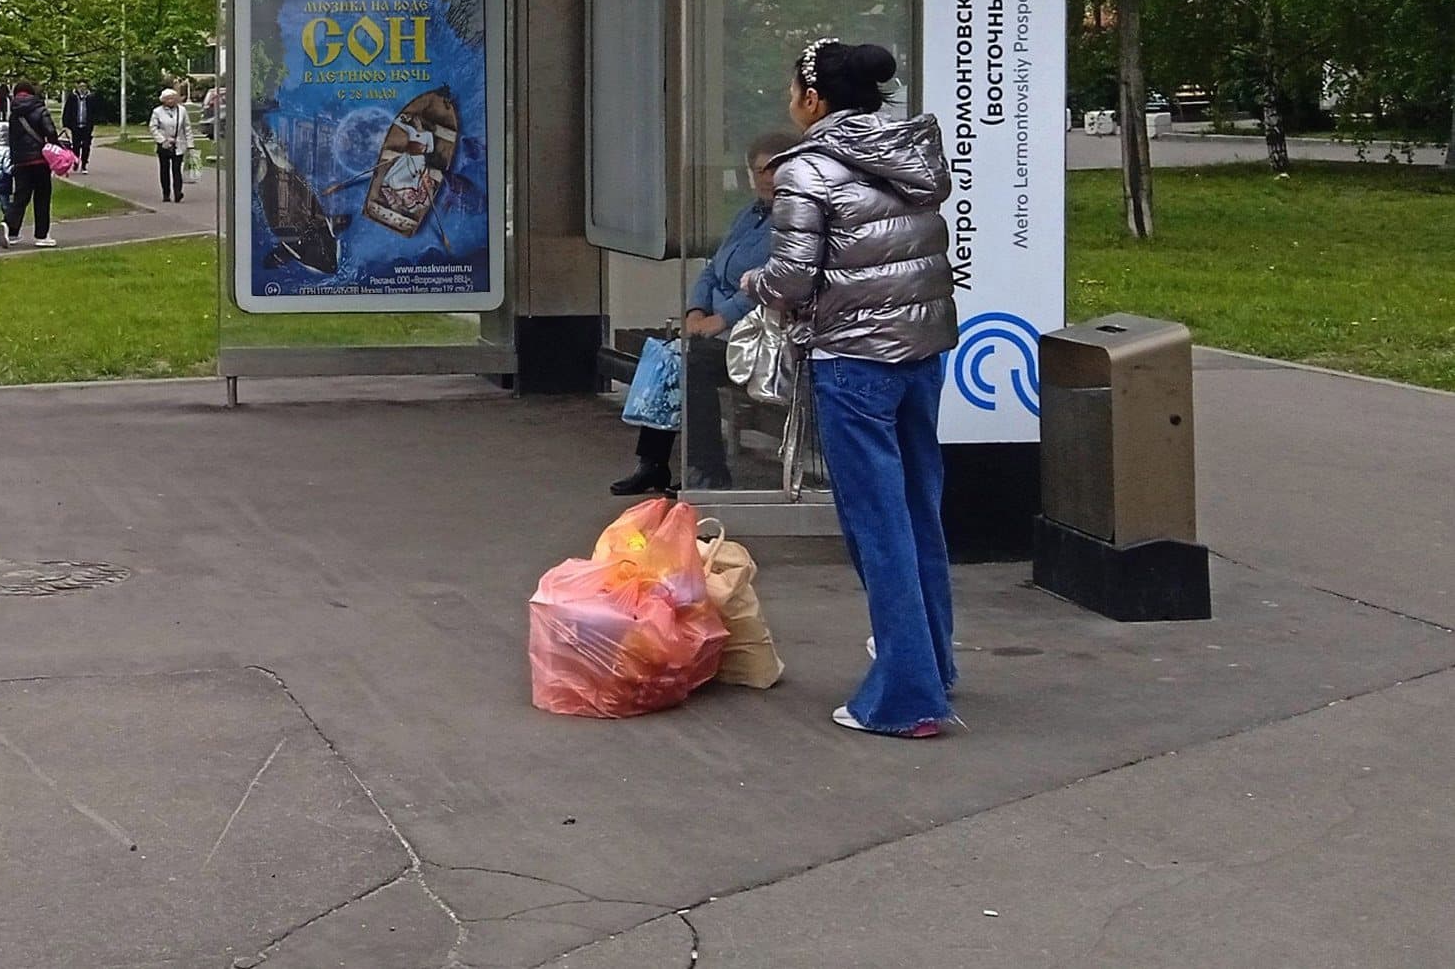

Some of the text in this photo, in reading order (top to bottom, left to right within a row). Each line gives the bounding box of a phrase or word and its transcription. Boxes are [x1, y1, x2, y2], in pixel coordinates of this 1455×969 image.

[371, 0, 390, 12] НА
[301, 15, 432, 67] СОН
[304, 69, 431, 83] В ЛЕТНЮЮ НОЧЬ
[366, 88, 397, 100] МАЯ
[1013, 59, 1032, 188] Lermontovskiy
[1013, 193, 1029, 249] Metro
[952, 198, 977, 290] Метро
[394, 264, 473, 273] www.moskvarium.ru
